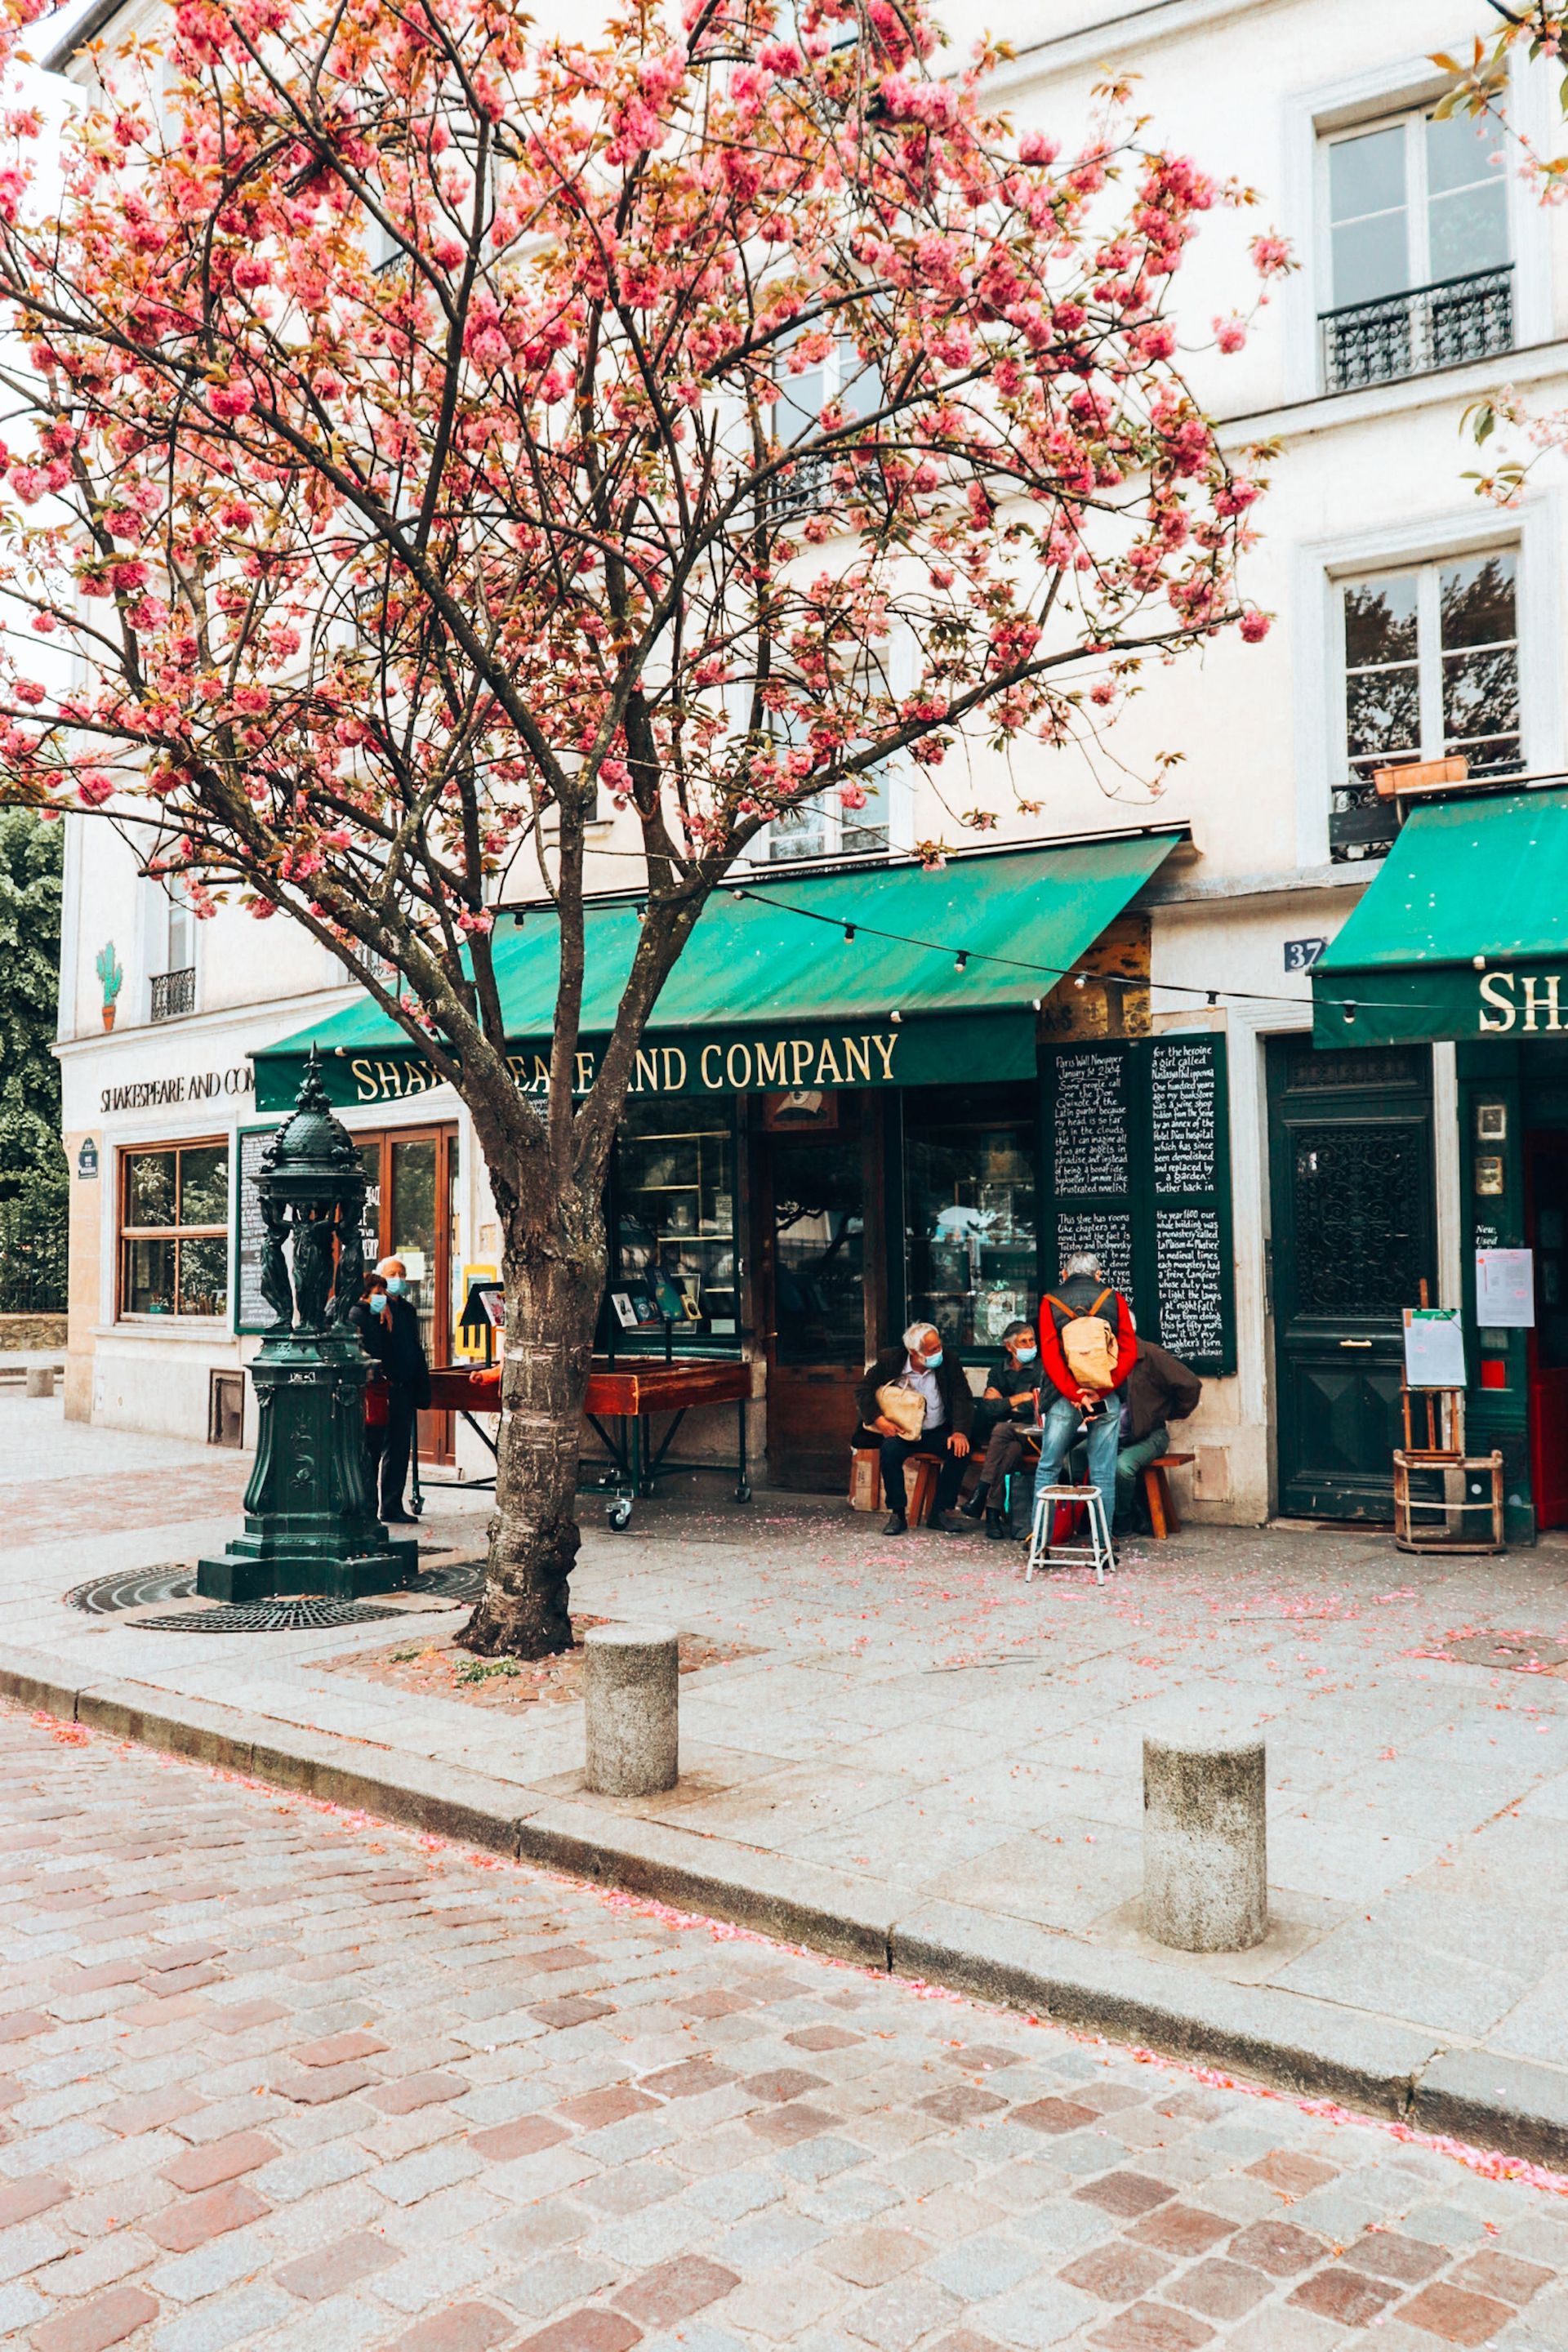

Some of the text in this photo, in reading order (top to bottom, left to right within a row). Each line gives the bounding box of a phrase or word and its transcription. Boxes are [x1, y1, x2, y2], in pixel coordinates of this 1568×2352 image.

[1291, 942, 1321, 968] 37
[1480, 972, 1568, 1031] SH
[1153, 1045, 1212, 1058] for the heroine
[627, 1049, 687, 1093] ND
[701, 1033, 898, 1089] COMPANY
[1159, 1057, 1176, 1070] girl
[1178, 1054, 1206, 1067] called
[1108, 1077, 1121, 1087] call
[1152, 1080, 1214, 1093] One hundred years
[100, 1076, 185, 1113] SHAKESPEARE
[188, 1072, 220, 1101] AND
[1080, 1088, 1093, 1098] the
[1096, 1087, 1113, 1098] Don
[1167, 1093, 1178, 1102] my
[1103, 1097, 1118, 1106] the
[1153, 1102, 1166, 1110] was
[1176, 1100, 1192, 1108] wine
[1194, 1099, 1213, 1111] shop
[1055, 1106, 1126, 1118] Latin because
[1187, 1107, 1197, 1117] the
[1067, 1116, 1086, 1126] head
[1153, 1120, 1161, 1130] by
[1192, 1116, 1201, 1129] of
[1201, 1119, 1214, 1128] the
[1080, 1126, 1093, 1135] the
[1097, 1125, 1124, 1134] clouds
[1185, 1128, 1214, 1141] hospital
[1116, 1134, 1127, 1143] all
[1089, 1145, 1114, 1155] angels
[1118, 1144, 1126, 1152] in
[1154, 1140, 1214, 1151] which has since
[1154, 1150, 1214, 1162] been demolished
[1155, 1161, 1214, 1175] and replaced by
[1174, 1171, 1210, 1183] garden.
[1156, 1181, 1214, 1193] Further back in
[1058, 1214, 1075, 1224] This
[1094, 1213, 1106, 1223] has
[1156, 1210, 1167, 1219] the
[1169, 1212, 1183, 1221] year
[1076, 1224, 1108, 1233] chapters
[1196, 1229, 1218, 1238] called
[1058, 1232, 1131, 1241] novel and the fact is
[1476, 1236, 1499, 1245] Used
[1084, 1241, 1096, 1250] and
[1111, 1251, 1118, 1259] to
[1157, 1250, 1165, 1260] In
[1197, 1250, 1218, 1260] times
[1158, 1260, 1172, 1268] each
[1207, 1260, 1220, 1270] had
[1116, 1276, 1131, 1285] the
[1159, 1279, 1179, 1288] whose
[1180, 1279, 1200, 1292] duty
[1159, 1290, 1200, 1303] to light the
[1165, 1300, 1174, 1310] at
[1160, 1307, 1222, 1323] I have been doing
[1160, 1321, 1175, 1330] this
[1176, 1320, 1186, 1332] for
[1161, 1330, 1178, 1339] Now
[1180, 1329, 1186, 1338] it
[1201, 1331, 1215, 1341] my
